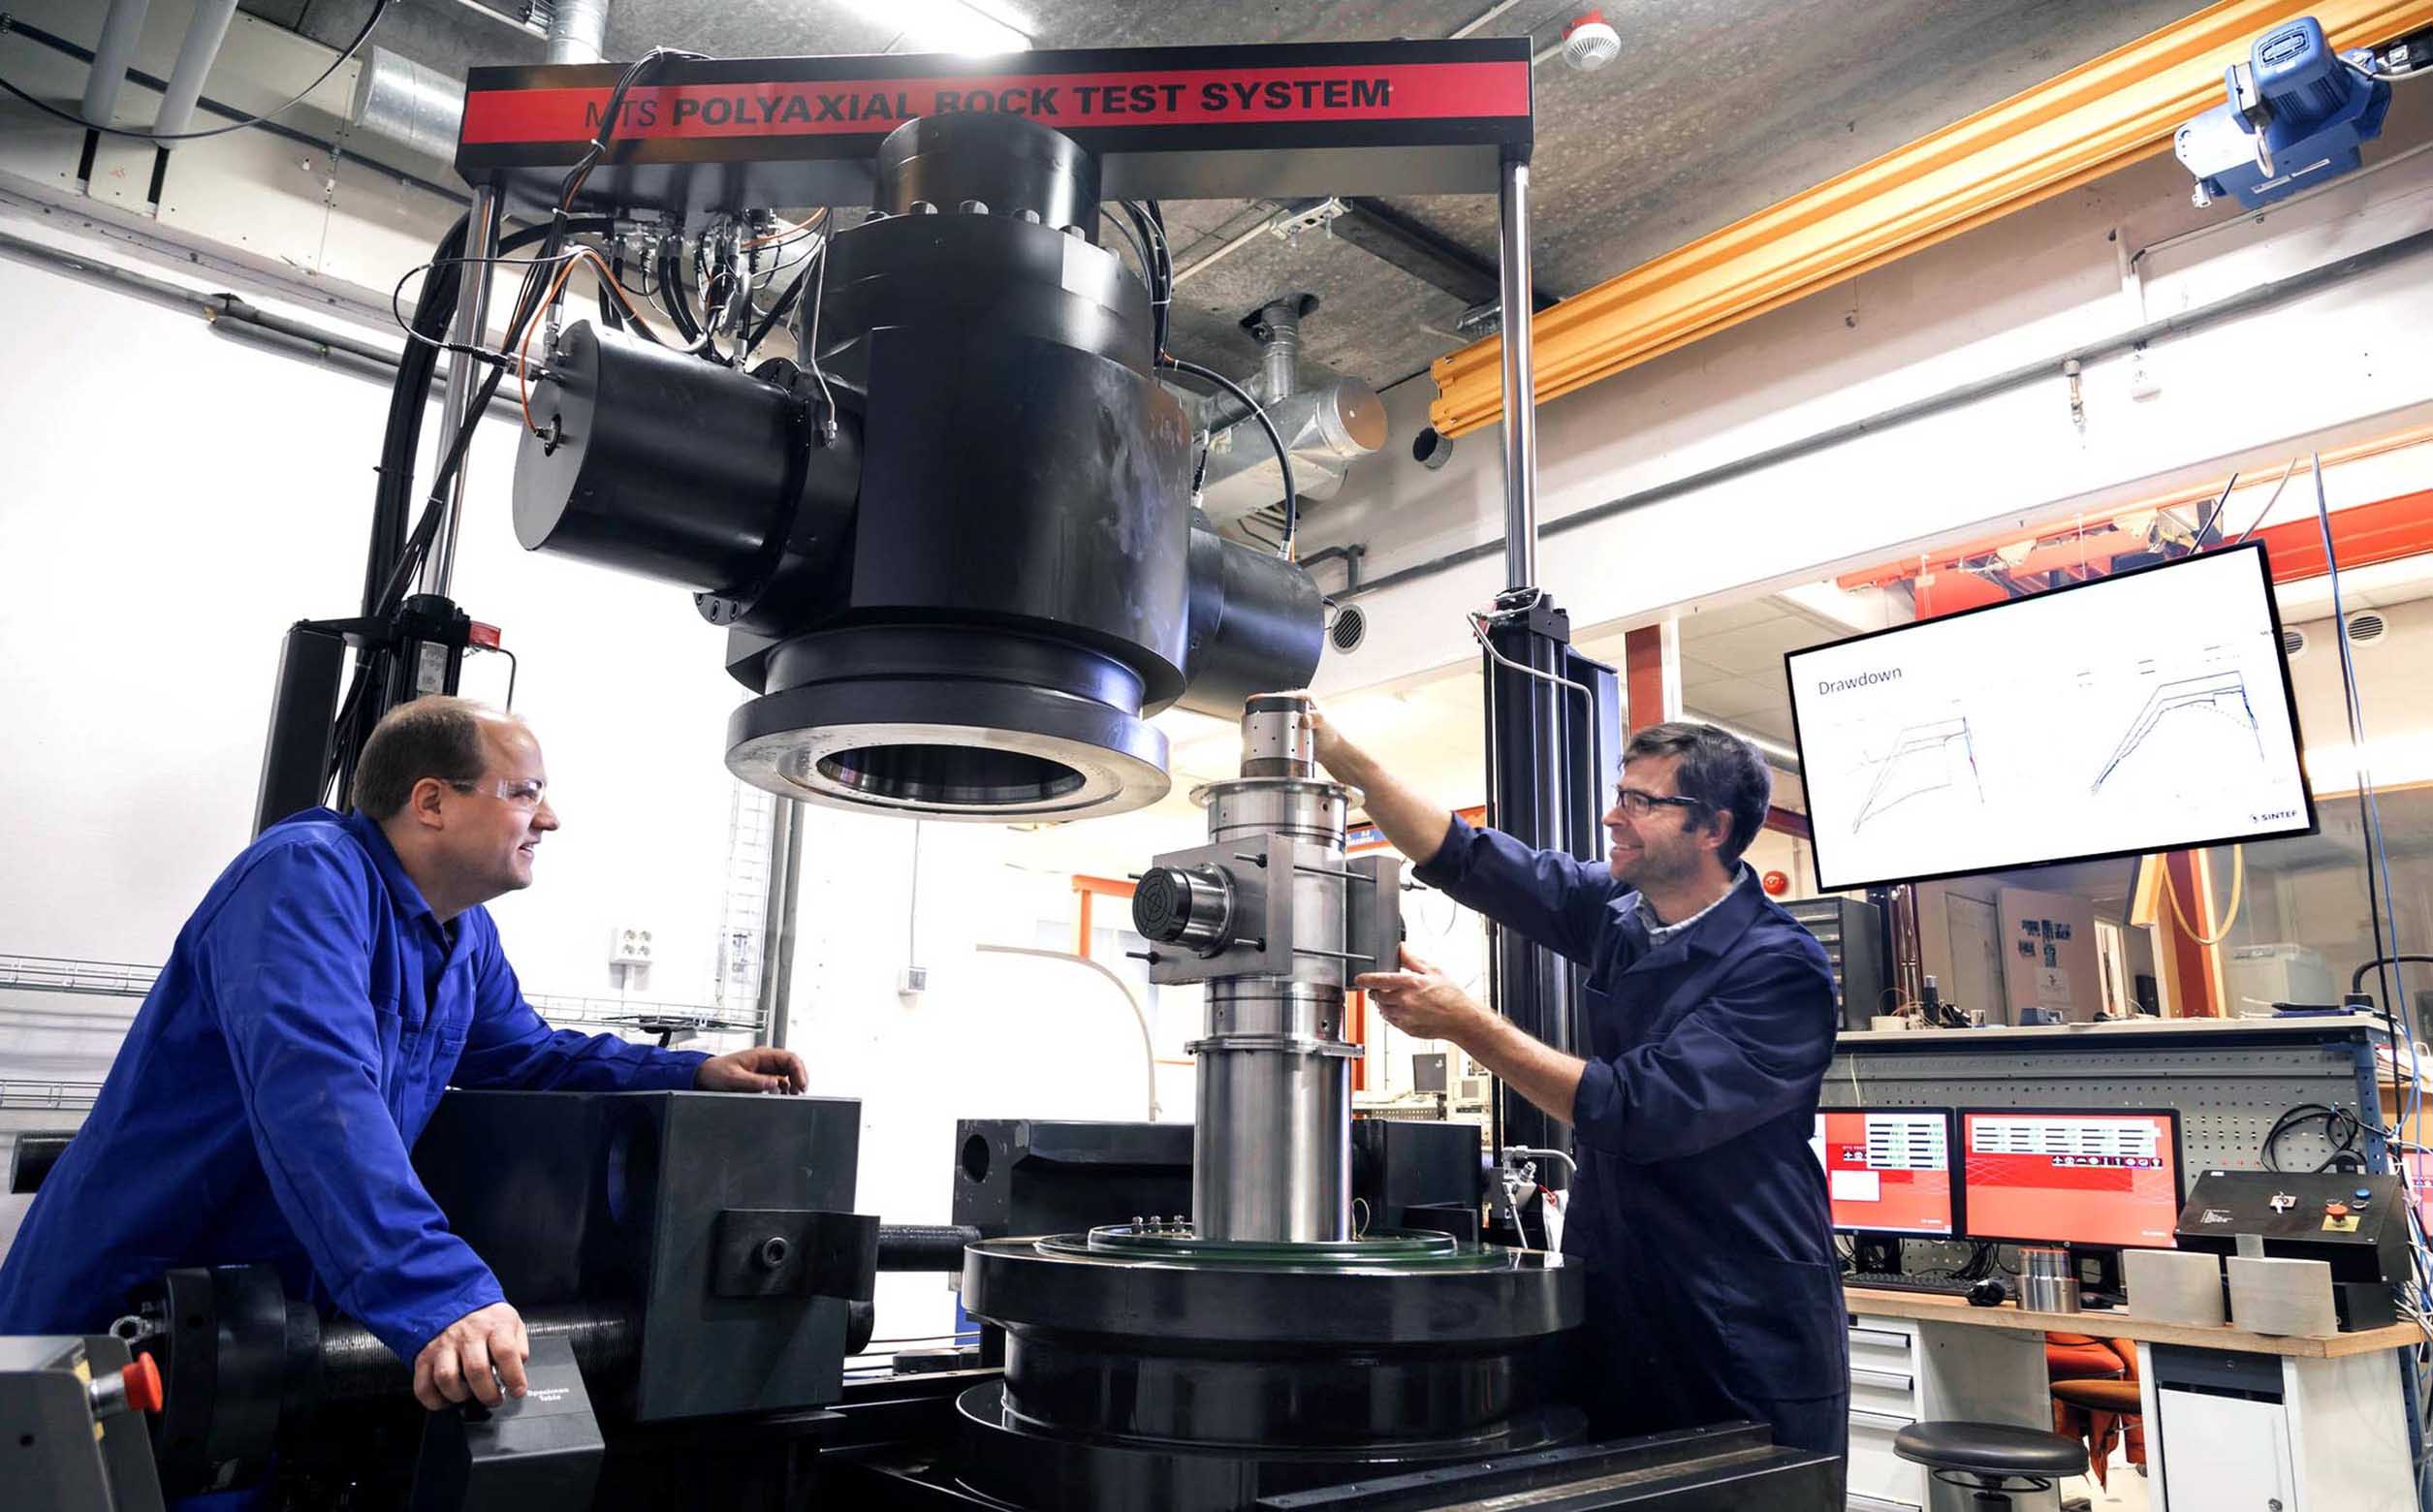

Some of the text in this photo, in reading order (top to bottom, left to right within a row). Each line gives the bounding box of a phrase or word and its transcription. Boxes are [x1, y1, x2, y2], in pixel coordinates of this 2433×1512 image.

[672, 92, 918, 126] POLYAXIAL
[934, 86, 1059, 115] ROCK
[1072, 83, 1187, 114] TEST
[1200, 79, 1390, 111] SYSTEM
[1818, 667, 1902, 695] Drawdown
[2261, 809, 2297, 821] SINTEF
